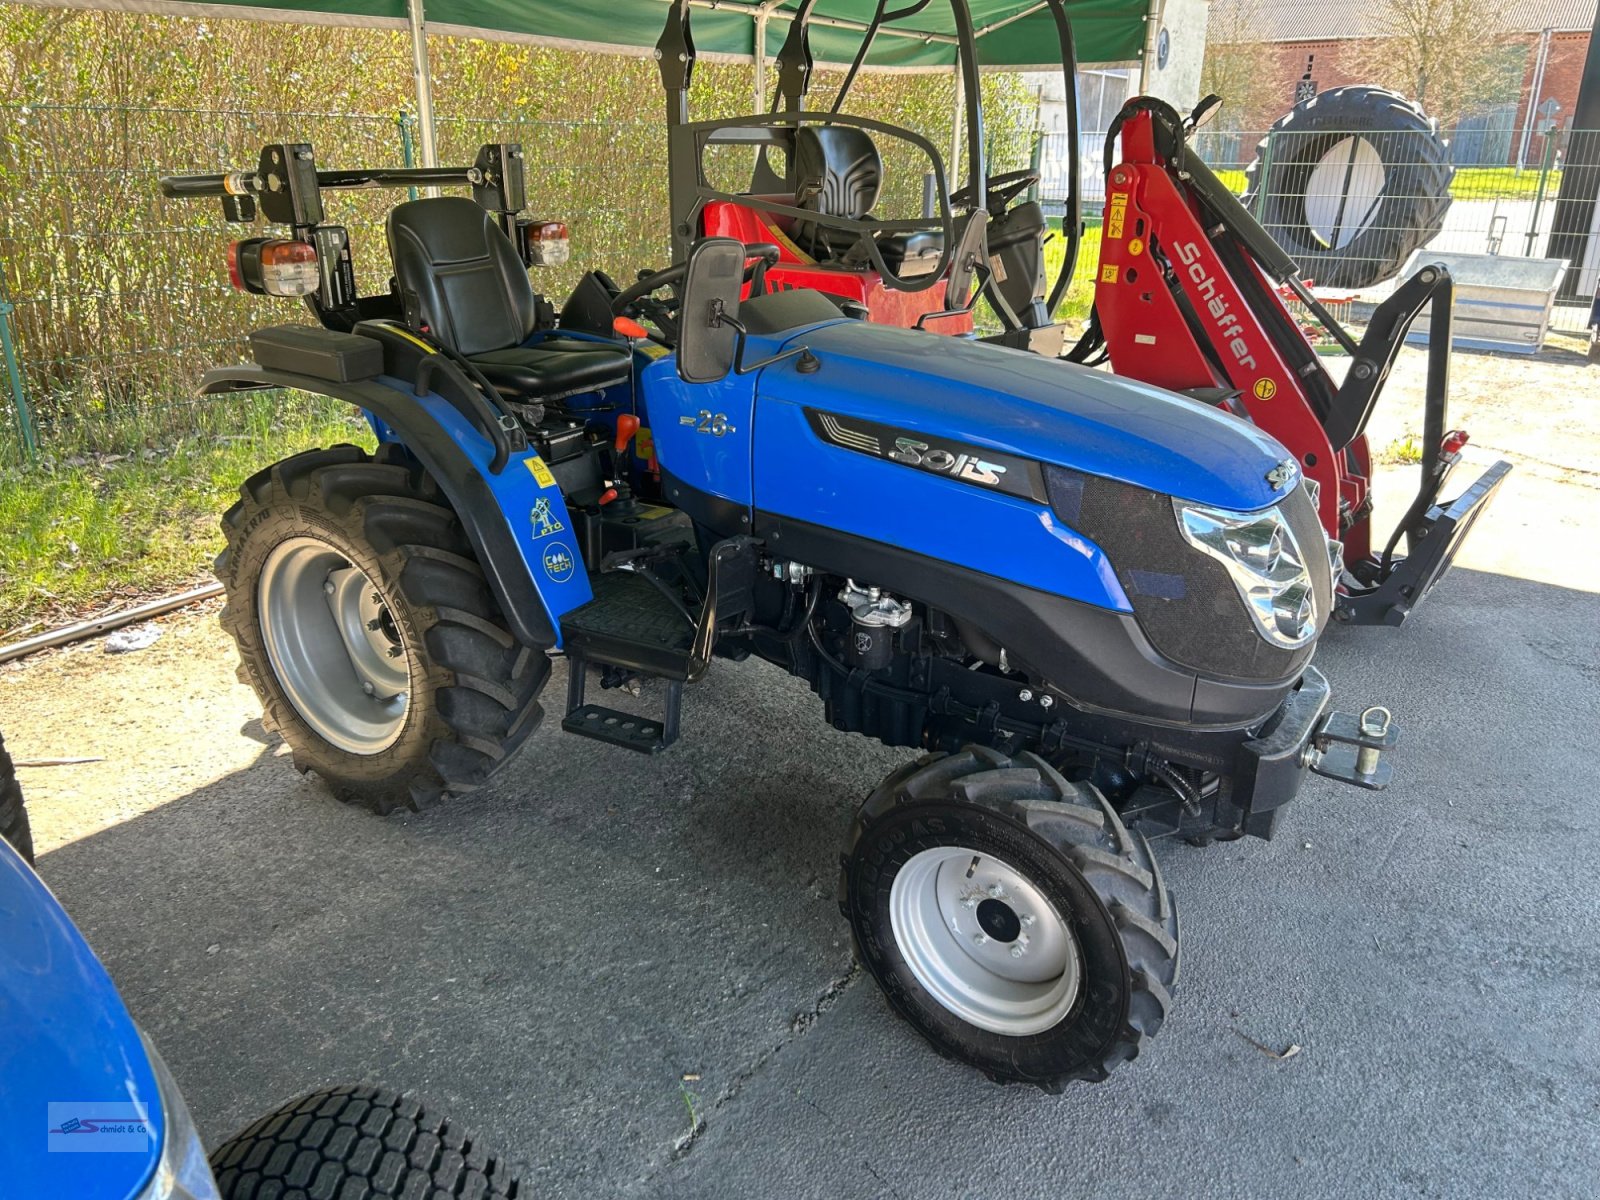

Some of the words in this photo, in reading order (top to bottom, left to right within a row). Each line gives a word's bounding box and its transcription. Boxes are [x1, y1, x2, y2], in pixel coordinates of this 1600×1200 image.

[1173, 240, 1256, 371] Schäffer
[540, 523, 562, 536] PTO
[545, 552, 570, 566] COOL
[547, 561, 572, 574] TECH
[394, 597, 418, 640] CEAT
